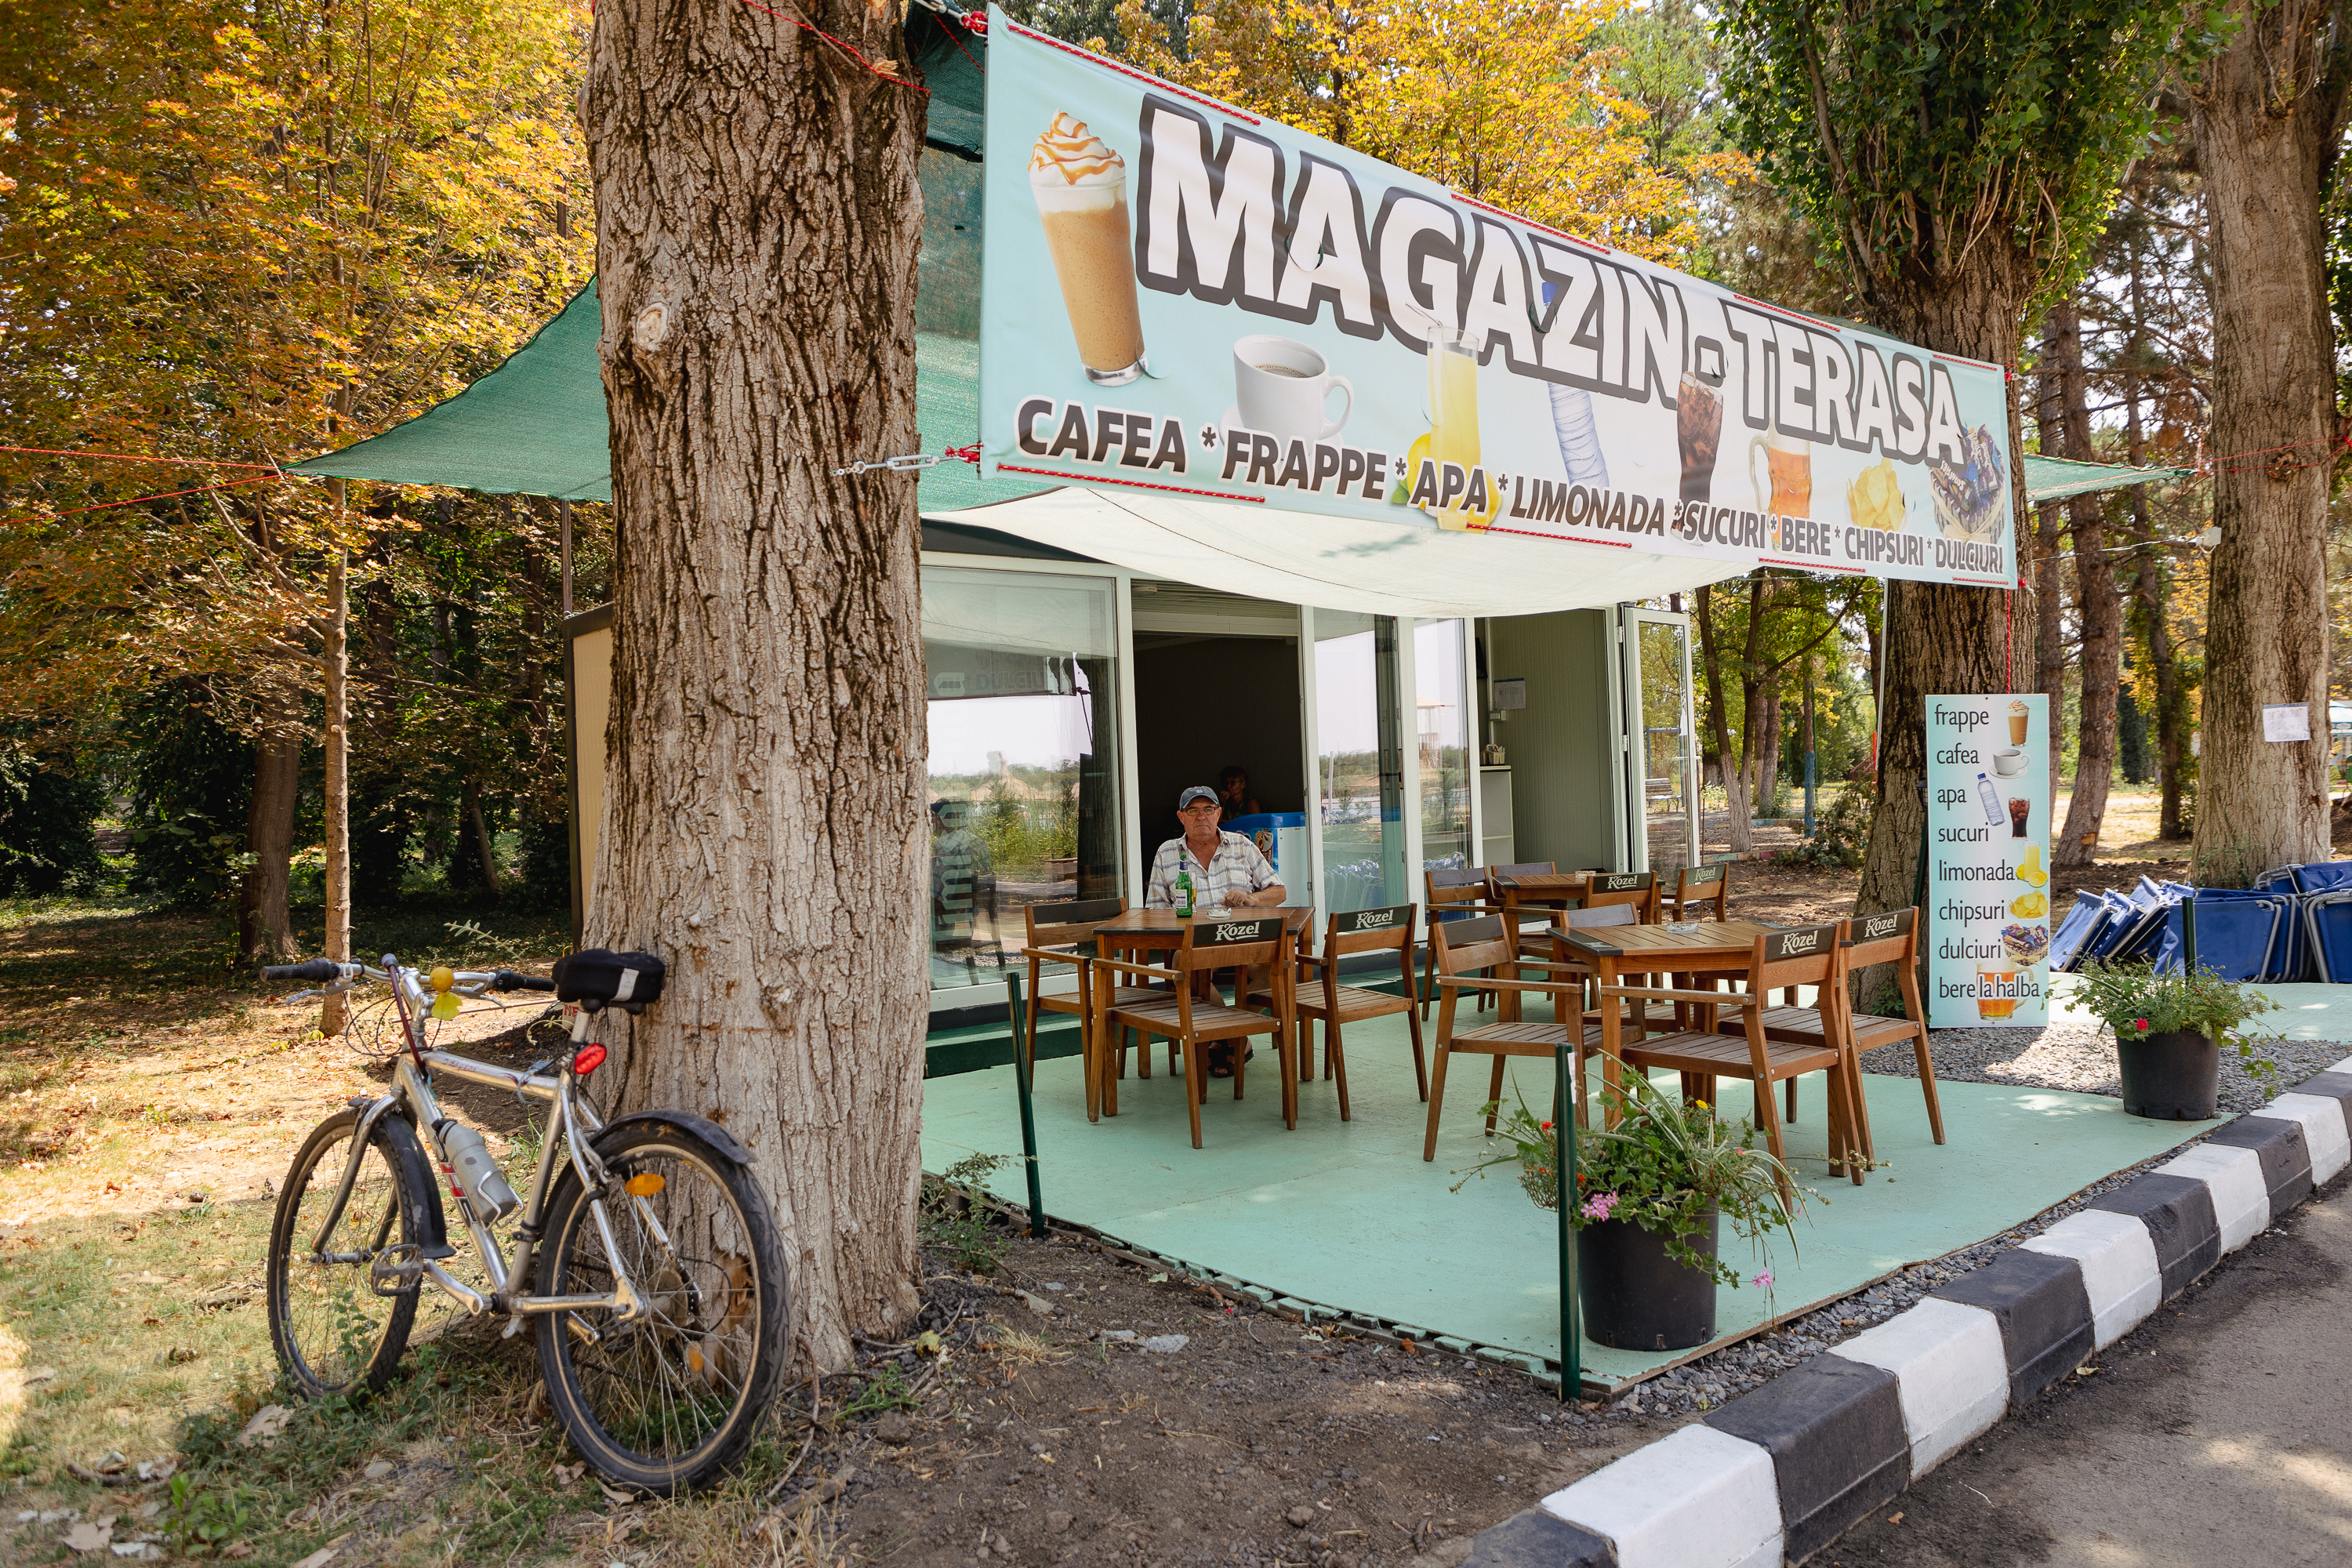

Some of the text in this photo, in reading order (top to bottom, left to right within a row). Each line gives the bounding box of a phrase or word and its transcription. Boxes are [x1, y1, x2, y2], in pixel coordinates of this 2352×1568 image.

[1019, 399, 2004, 574] CAFEA FRAPPE APA LIMONADA SUCURI BERE CHIPSURI DULCIURI
[1935, 704, 1989, 733] frappe
[1936, 742, 1980, 764] cafea
[1937, 789, 1967, 811] apa
[1938, 822, 1989, 843] sucuri
[1695, 866, 1715, 881] Kozel
[1939, 859, 2016, 881] limonada
[1607, 874, 1638, 890] Kozel
[1356, 909, 1394, 929] Kozel
[1939, 899, 2005, 927] chipsuri
[1214, 921, 1260, 941] Kozel
[1864, 913, 1898, 938] Kozel
[1780, 930, 1818, 955] Kozel
[1939, 938, 2001, 959] dulciuri
[1939, 975, 2040, 998] bere la halba
